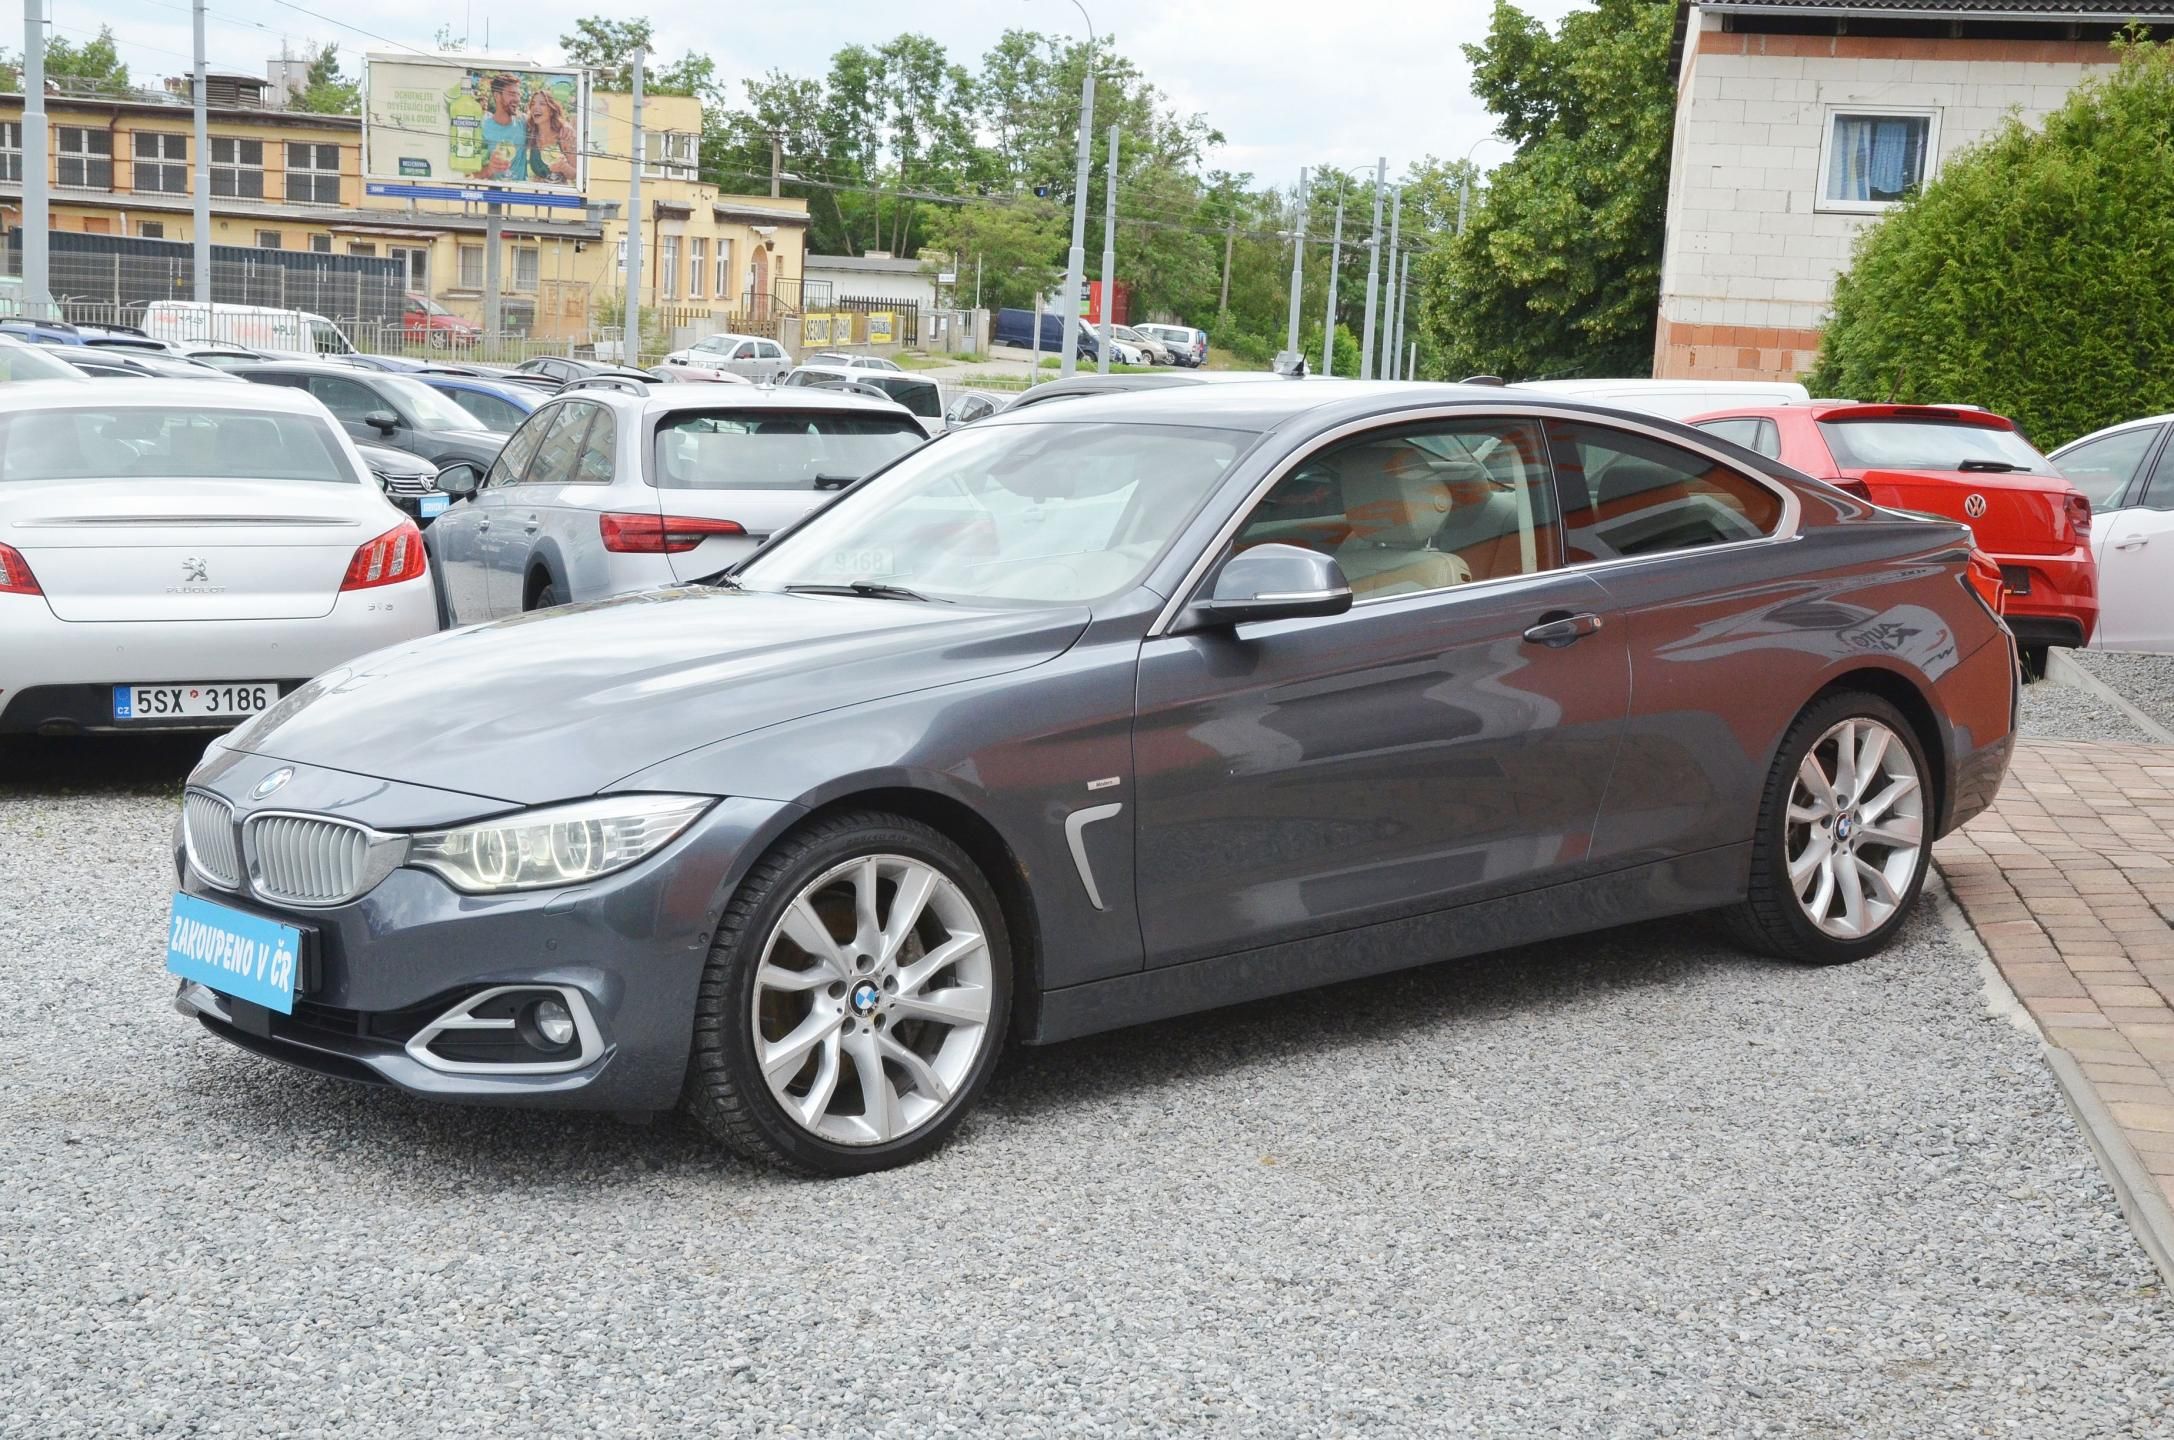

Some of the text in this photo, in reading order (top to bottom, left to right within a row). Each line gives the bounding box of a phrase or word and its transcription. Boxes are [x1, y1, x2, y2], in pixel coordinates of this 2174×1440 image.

[805, 319, 830, 341] SECOND
[117, 687, 266, 715] CZ 5SX 3186
[171, 915, 292, 993] ZAKOUPENO V ČR
